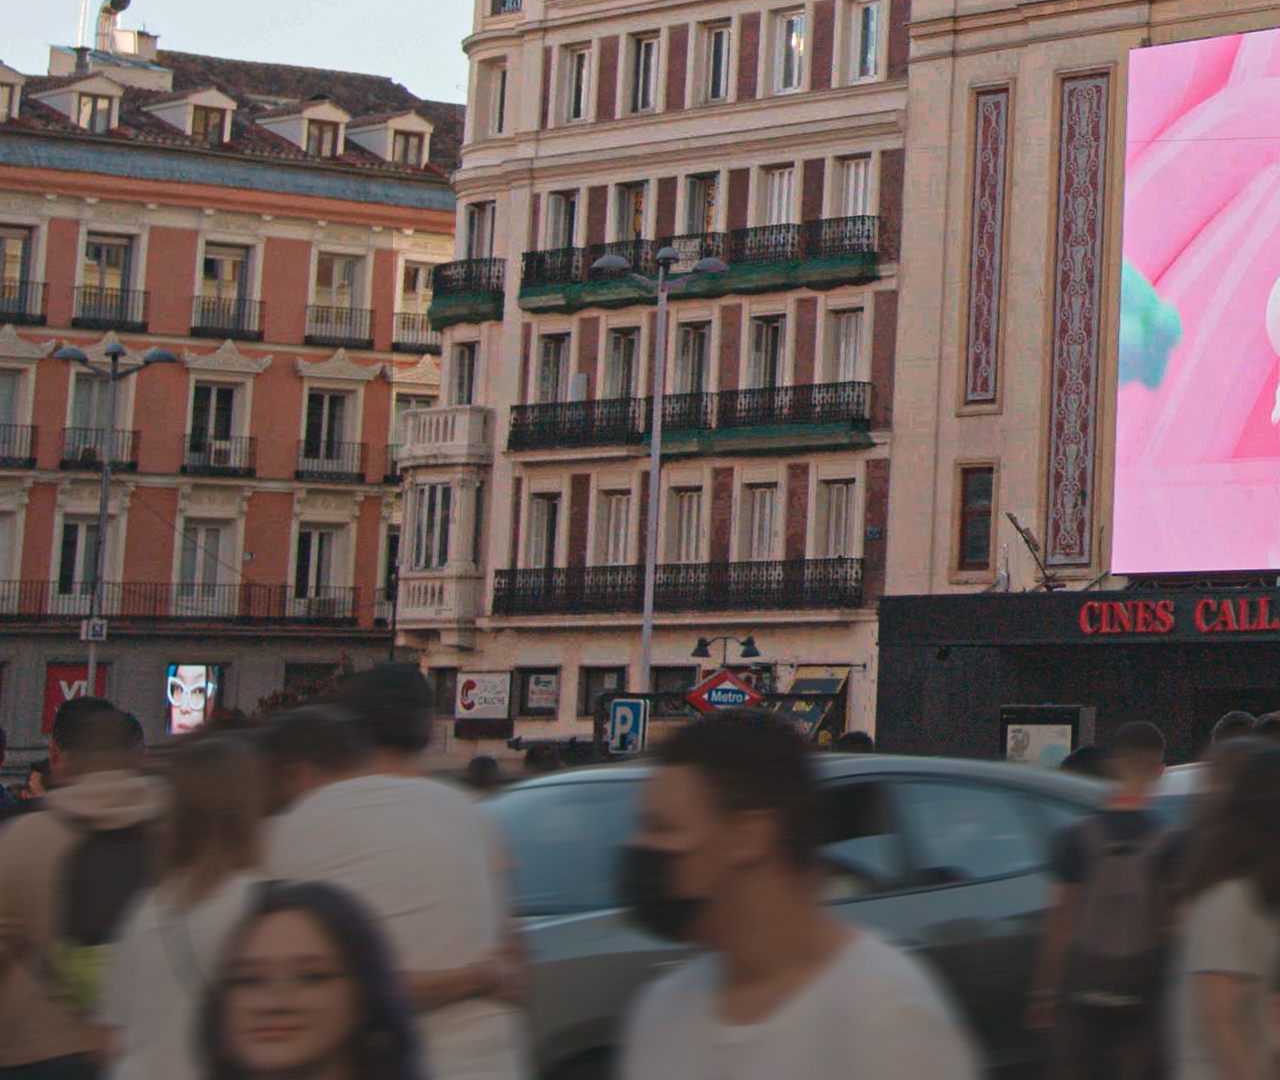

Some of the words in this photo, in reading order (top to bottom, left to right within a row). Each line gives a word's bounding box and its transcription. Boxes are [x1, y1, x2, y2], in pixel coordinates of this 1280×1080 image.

[1079, 600, 1175, 635] CINES
[710, 690, 744, 703] Metro
[614, 705, 634, 750] P
